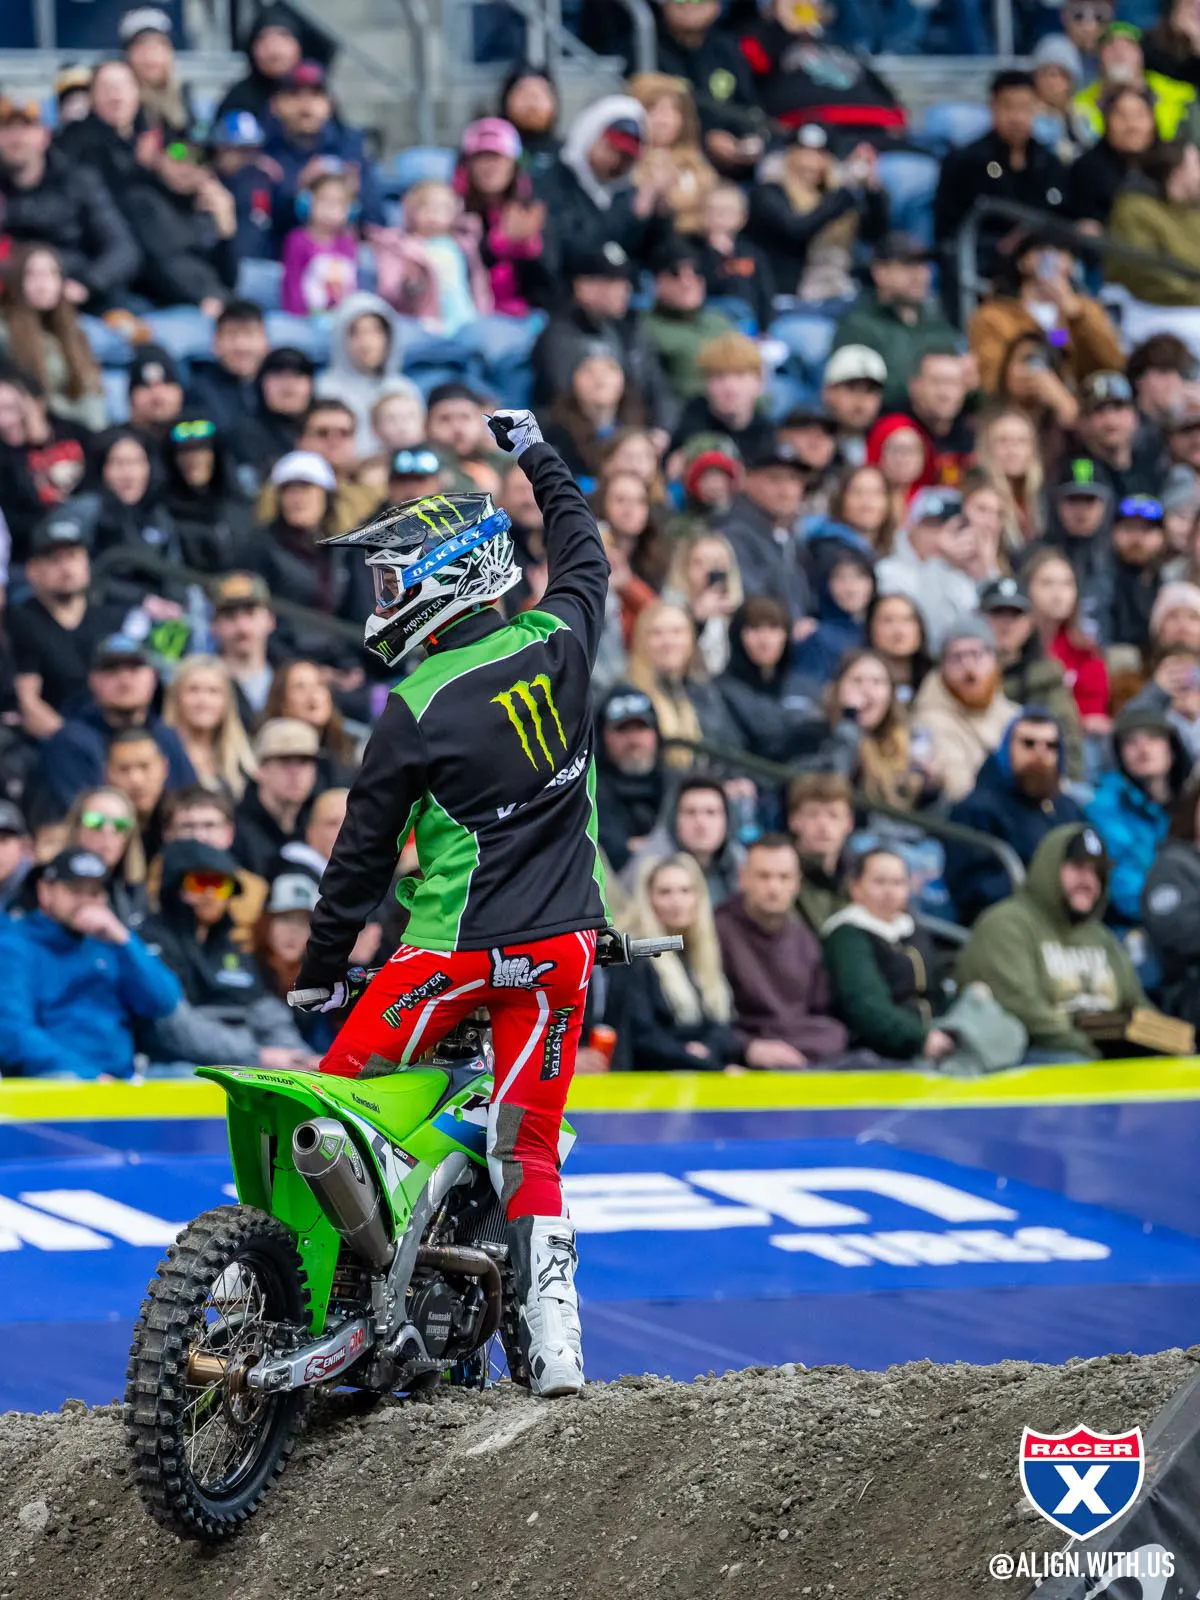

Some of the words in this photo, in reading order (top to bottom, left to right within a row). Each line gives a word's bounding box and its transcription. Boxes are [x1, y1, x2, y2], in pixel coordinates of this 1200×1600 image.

[412, 530, 483, 577] OAKLEY
[403, 597, 446, 635] MONSTER
[394, 971, 447, 1012] MONSTER
[550, 1016, 568, 1077] MONSTER
[256, 1073, 294, 1087] DUNLOP
